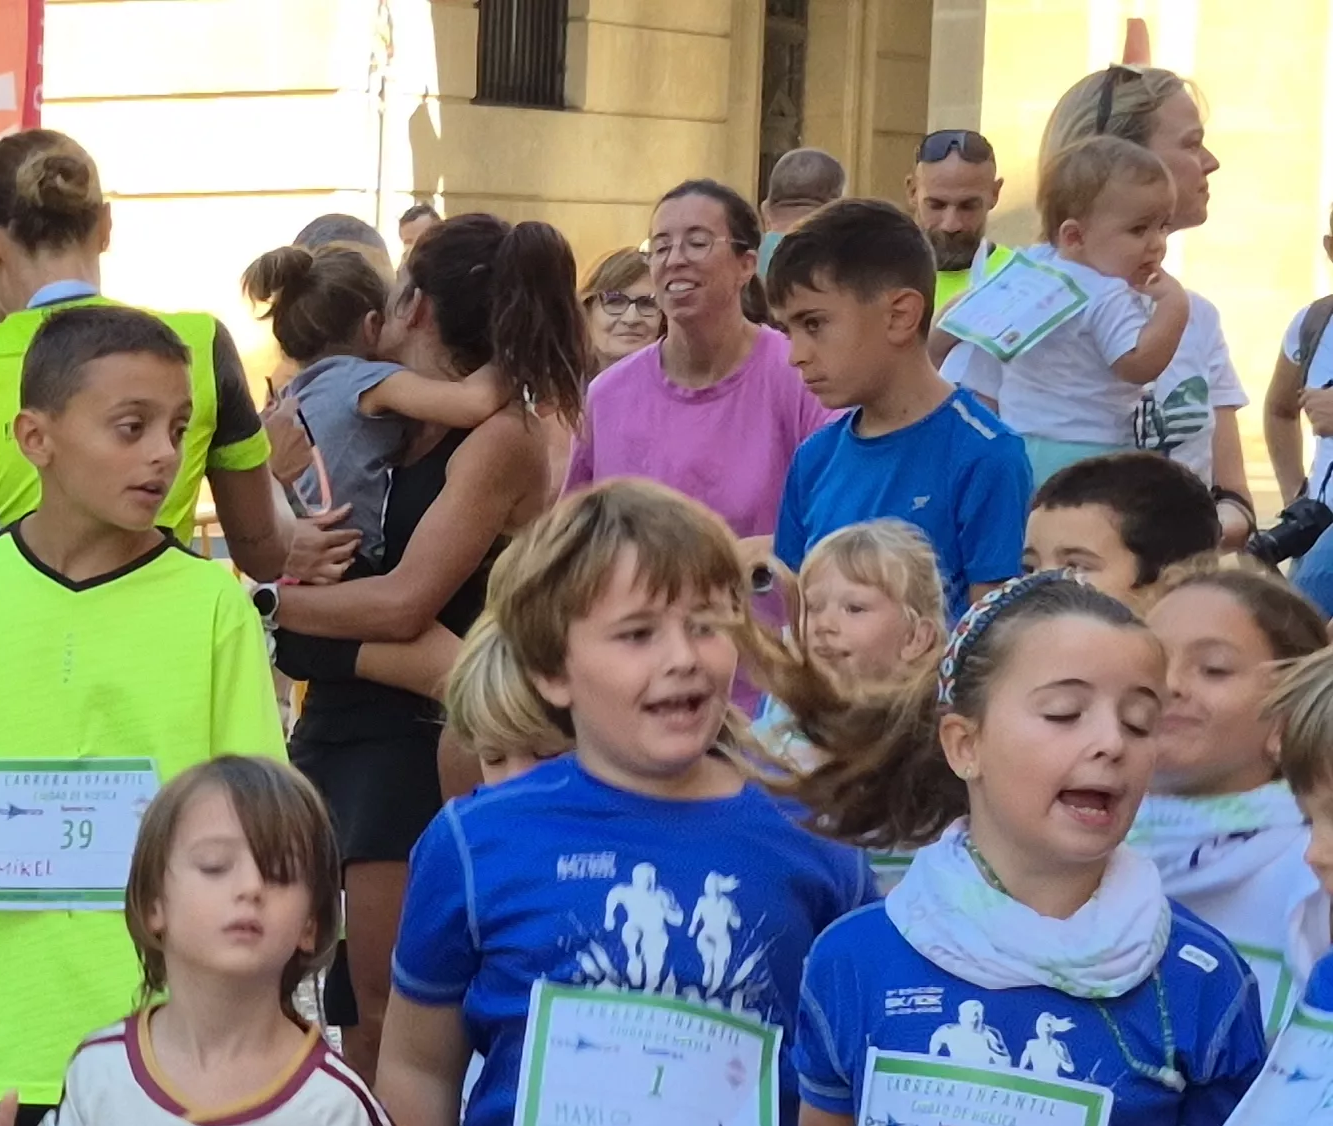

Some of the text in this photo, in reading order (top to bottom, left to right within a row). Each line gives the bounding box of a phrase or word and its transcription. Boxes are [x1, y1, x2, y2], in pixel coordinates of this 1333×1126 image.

[60, 819, 94, 850] 39
[647, 1065, 665, 1099] 1
[886, 1075, 1058, 1117] CARRERA INFANTIL
